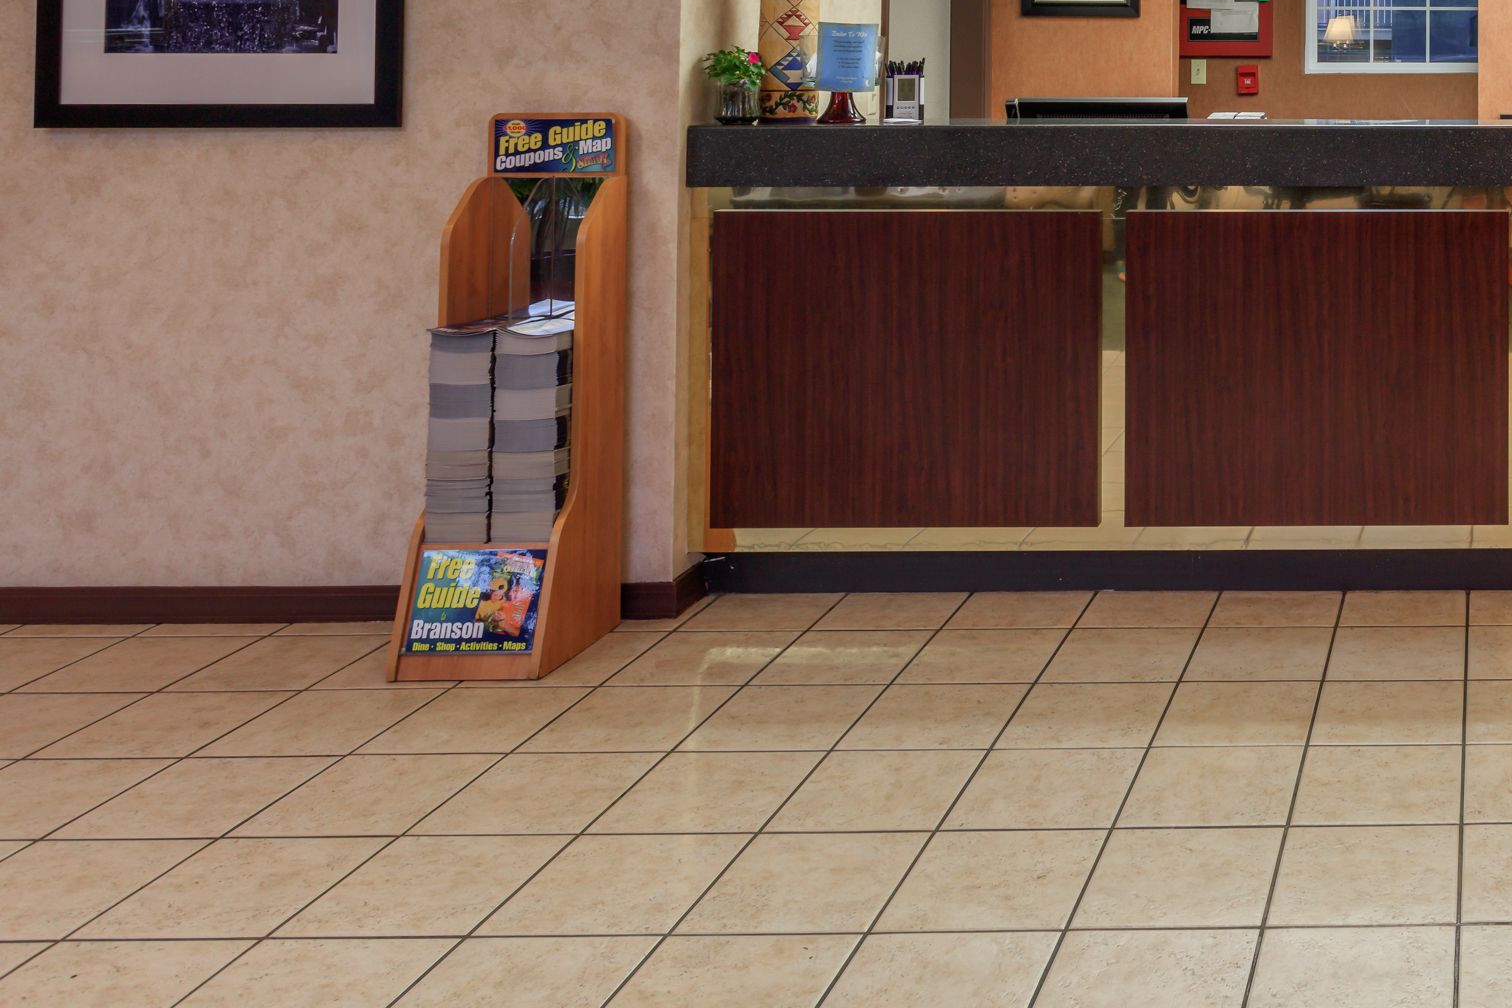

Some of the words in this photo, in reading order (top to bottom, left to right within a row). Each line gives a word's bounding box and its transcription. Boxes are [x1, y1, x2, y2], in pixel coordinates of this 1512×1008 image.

[499, 133, 543, 155] Free
[548, 119, 606, 146] Guide
[495, 147, 563, 171] Coupons
[578, 137, 612, 155] Map
[427, 554, 476, 580] Free
[417, 582, 481, 609] Guide
[411, 619, 485, 640] Branson
[412, 642, 429, 651] Dine
[436, 641, 455, 652] Shop
[460, 641, 497, 651] Activities
[503, 641, 526, 651] Maps
